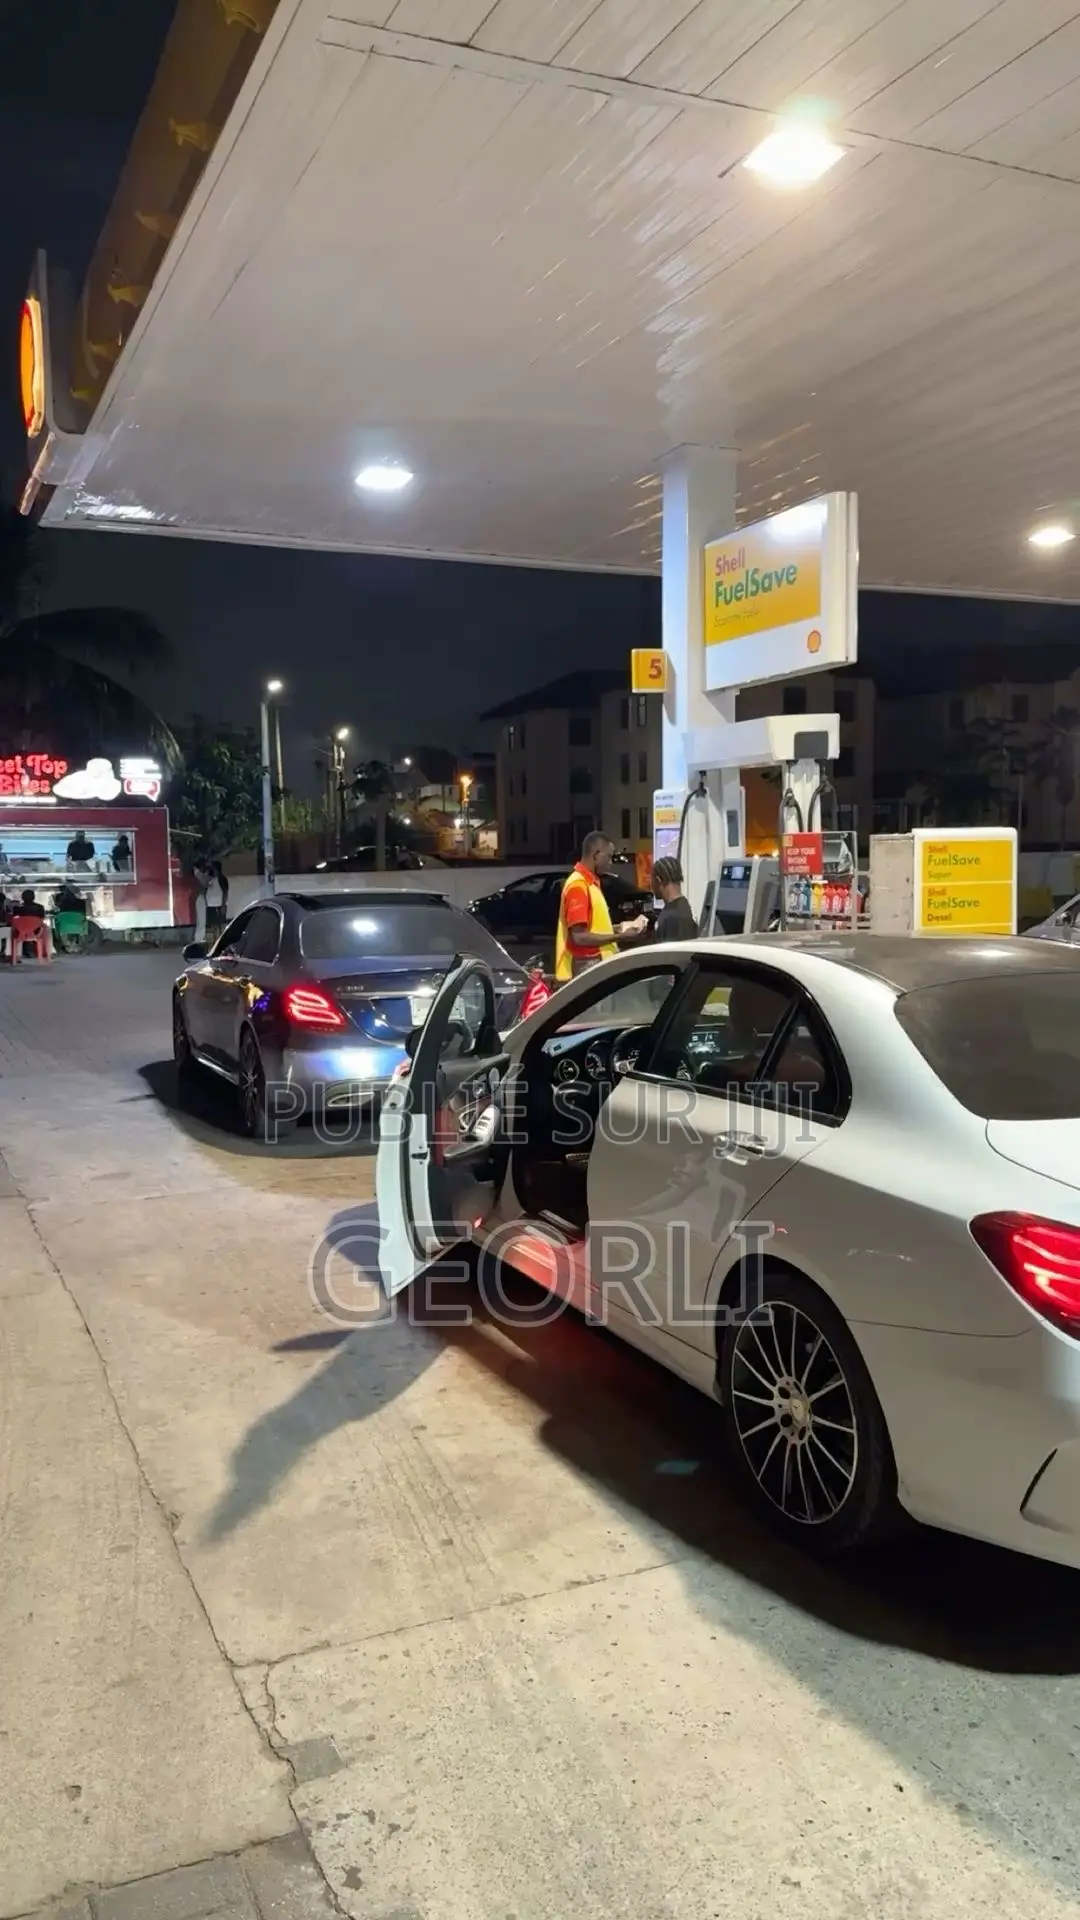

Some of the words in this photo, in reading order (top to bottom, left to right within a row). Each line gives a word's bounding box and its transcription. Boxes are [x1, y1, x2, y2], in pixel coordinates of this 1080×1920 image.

[715, 546, 745, 576] Shell
[715, 564, 797, 608] FuelSave
[649, 658, 662, 679] 5
[26, 754, 68, 779] Top
[927, 853, 981, 866] FuelSave
[927, 897, 980, 909] FuelSave
